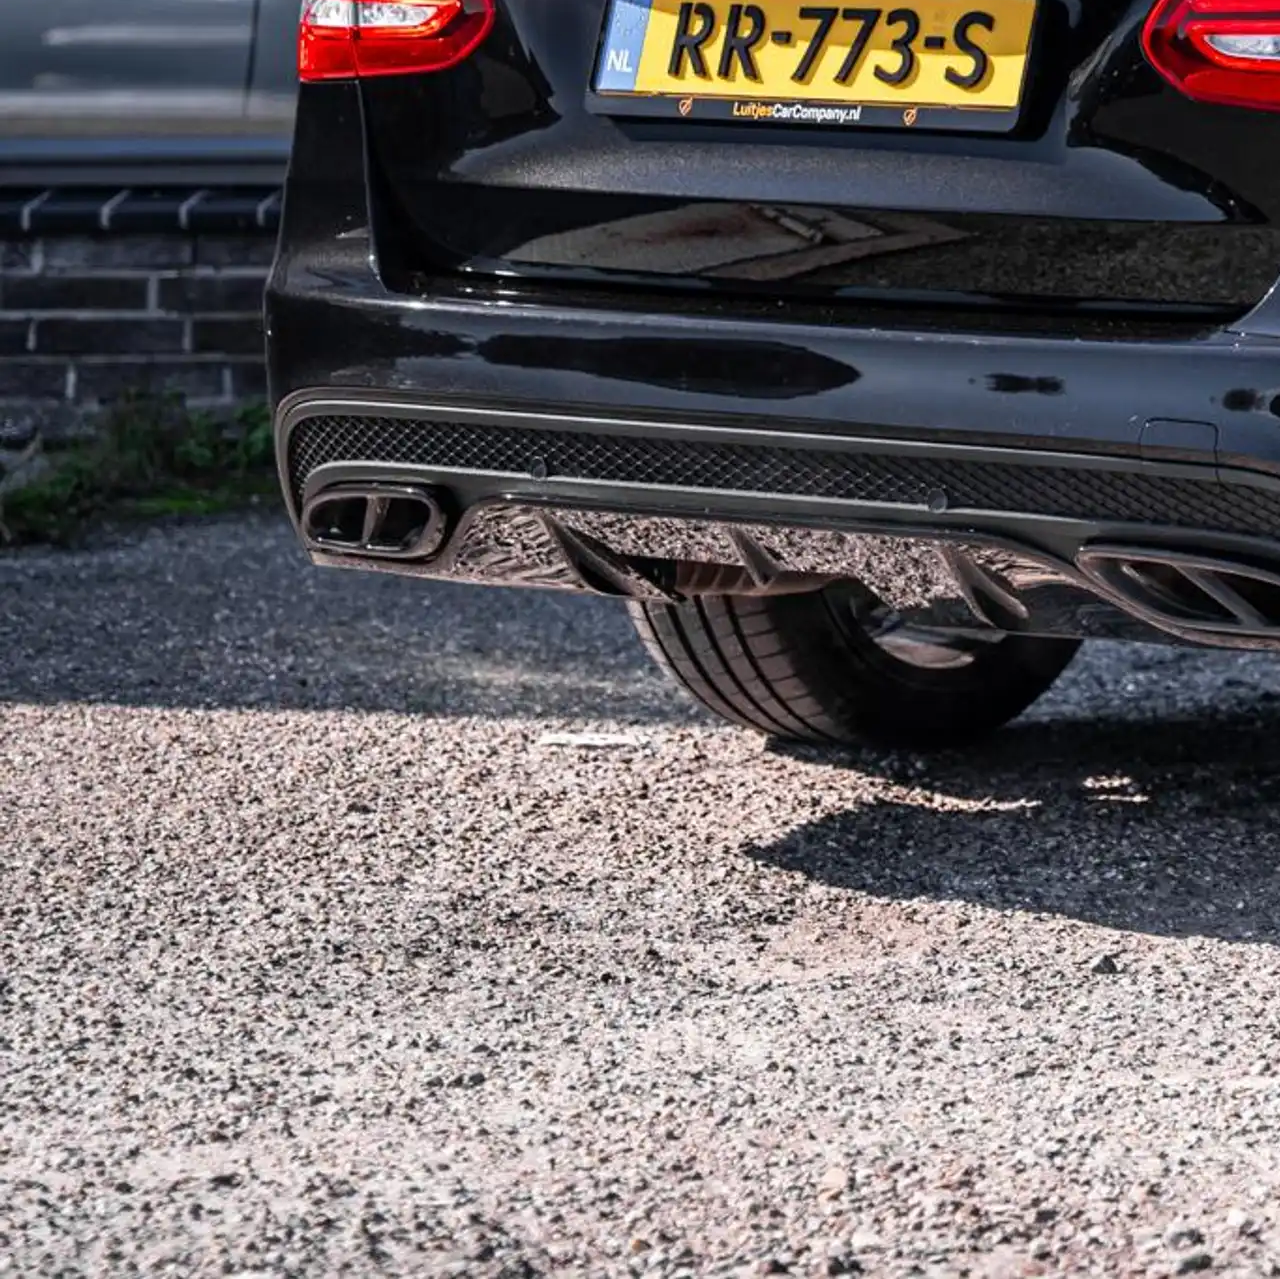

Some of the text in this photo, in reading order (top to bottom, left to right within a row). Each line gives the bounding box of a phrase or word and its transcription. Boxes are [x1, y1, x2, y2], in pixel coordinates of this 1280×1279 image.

[667, 2, 995, 88] RR-773-S
[607, 50, 633, 73] NL
[733, 101, 862, 122] LuitjesCarCompany.nl
